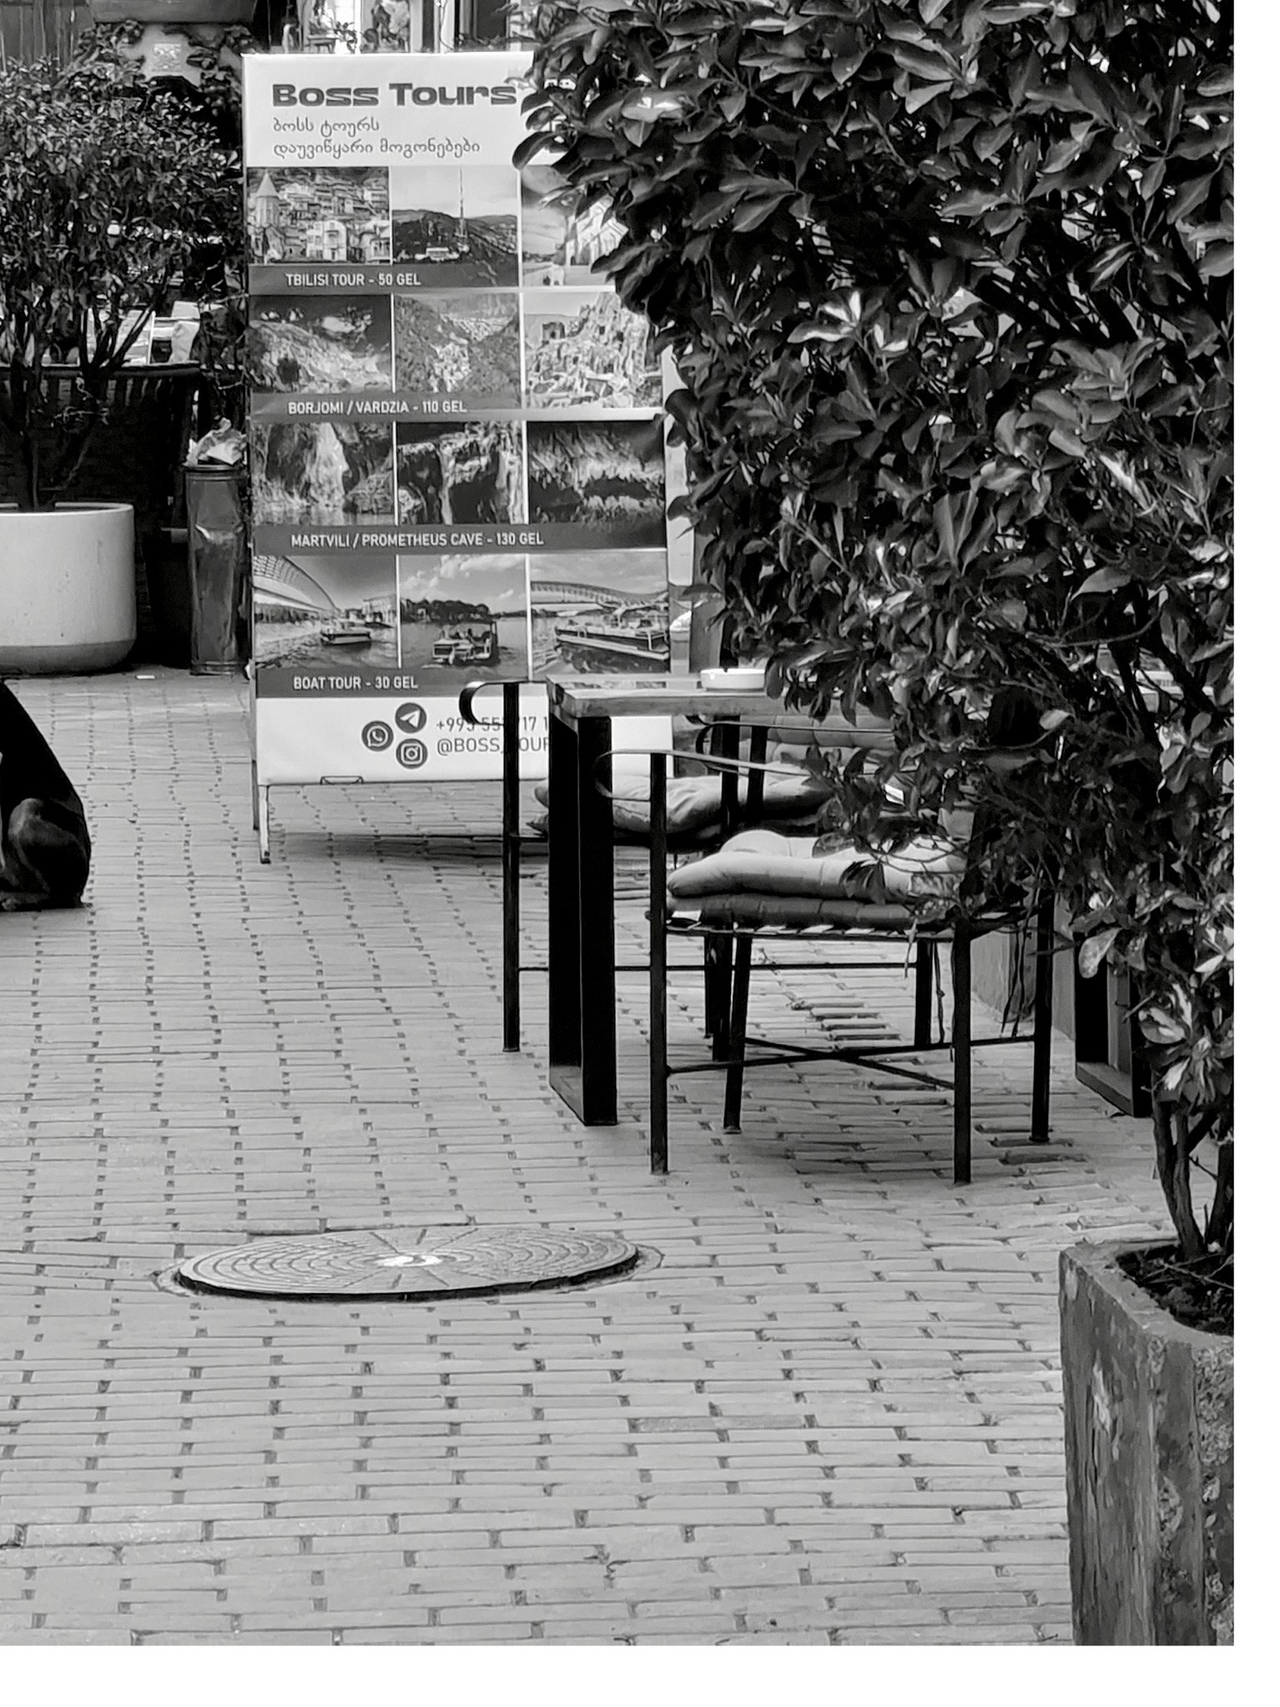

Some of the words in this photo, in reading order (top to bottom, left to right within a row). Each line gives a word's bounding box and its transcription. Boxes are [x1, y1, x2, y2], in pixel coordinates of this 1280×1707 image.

[272, 84, 379, 107] Boss
[389, 82, 517, 106] Tours
[273, 116, 314, 132] ბოსს
[320, 117, 380, 138] ტოურს
[380, 137, 481, 159] მოგონებები
[285, 273, 329, 286] TBILISI
[331, 273, 365, 286] TOUR
[378, 273, 393, 286] 50
[396, 273, 422, 286] GEL
[288, 402, 343, 415] BORJOMI
[346, 400, 354, 416] /
[355, 401, 409, 414] VARDZIA
[422, 401, 439, 413] 110
[442, 400, 468, 413] GEL
[291, 533, 350, 548] MARTVILI
[361, 533, 447, 547] PROMETHEUS
[450, 533, 483, 546] CAVE
[496, 532, 516, 545] 130
[519, 532, 544, 545] GEL
[293, 676, 326, 689] BOAT
[328, 676, 361, 689] TOUR
[375, 676, 390, 689] 30
[393, 676, 418, 689] GEL
